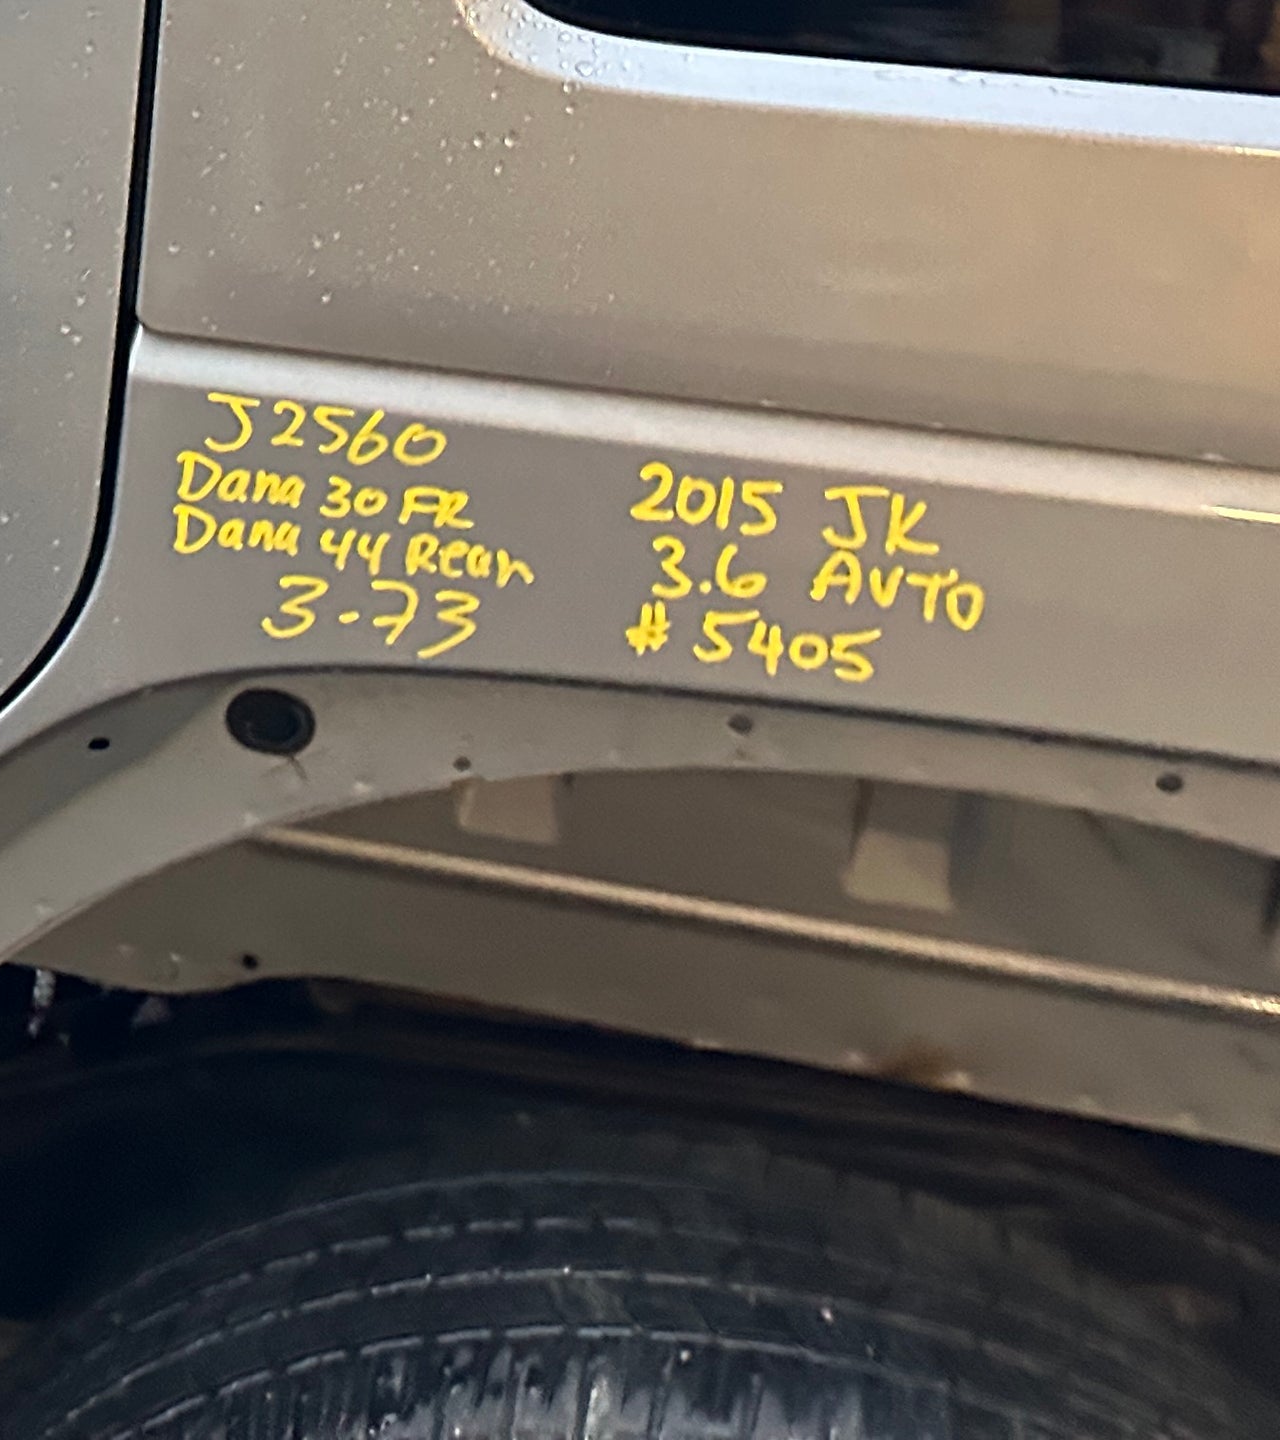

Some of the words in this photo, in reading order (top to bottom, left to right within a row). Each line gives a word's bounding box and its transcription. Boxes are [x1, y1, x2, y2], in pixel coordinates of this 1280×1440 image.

[203, 390, 449, 468] J2560
[175, 449, 307, 510] Dana
[317, 473, 390, 520] 30
[629, 460, 786, 538] 2015
[822, 484, 942, 558] JK
[172, 501, 303, 558] Dana
[318, 526, 391, 578] 44
[650, 533, 770, 601] 3.6
